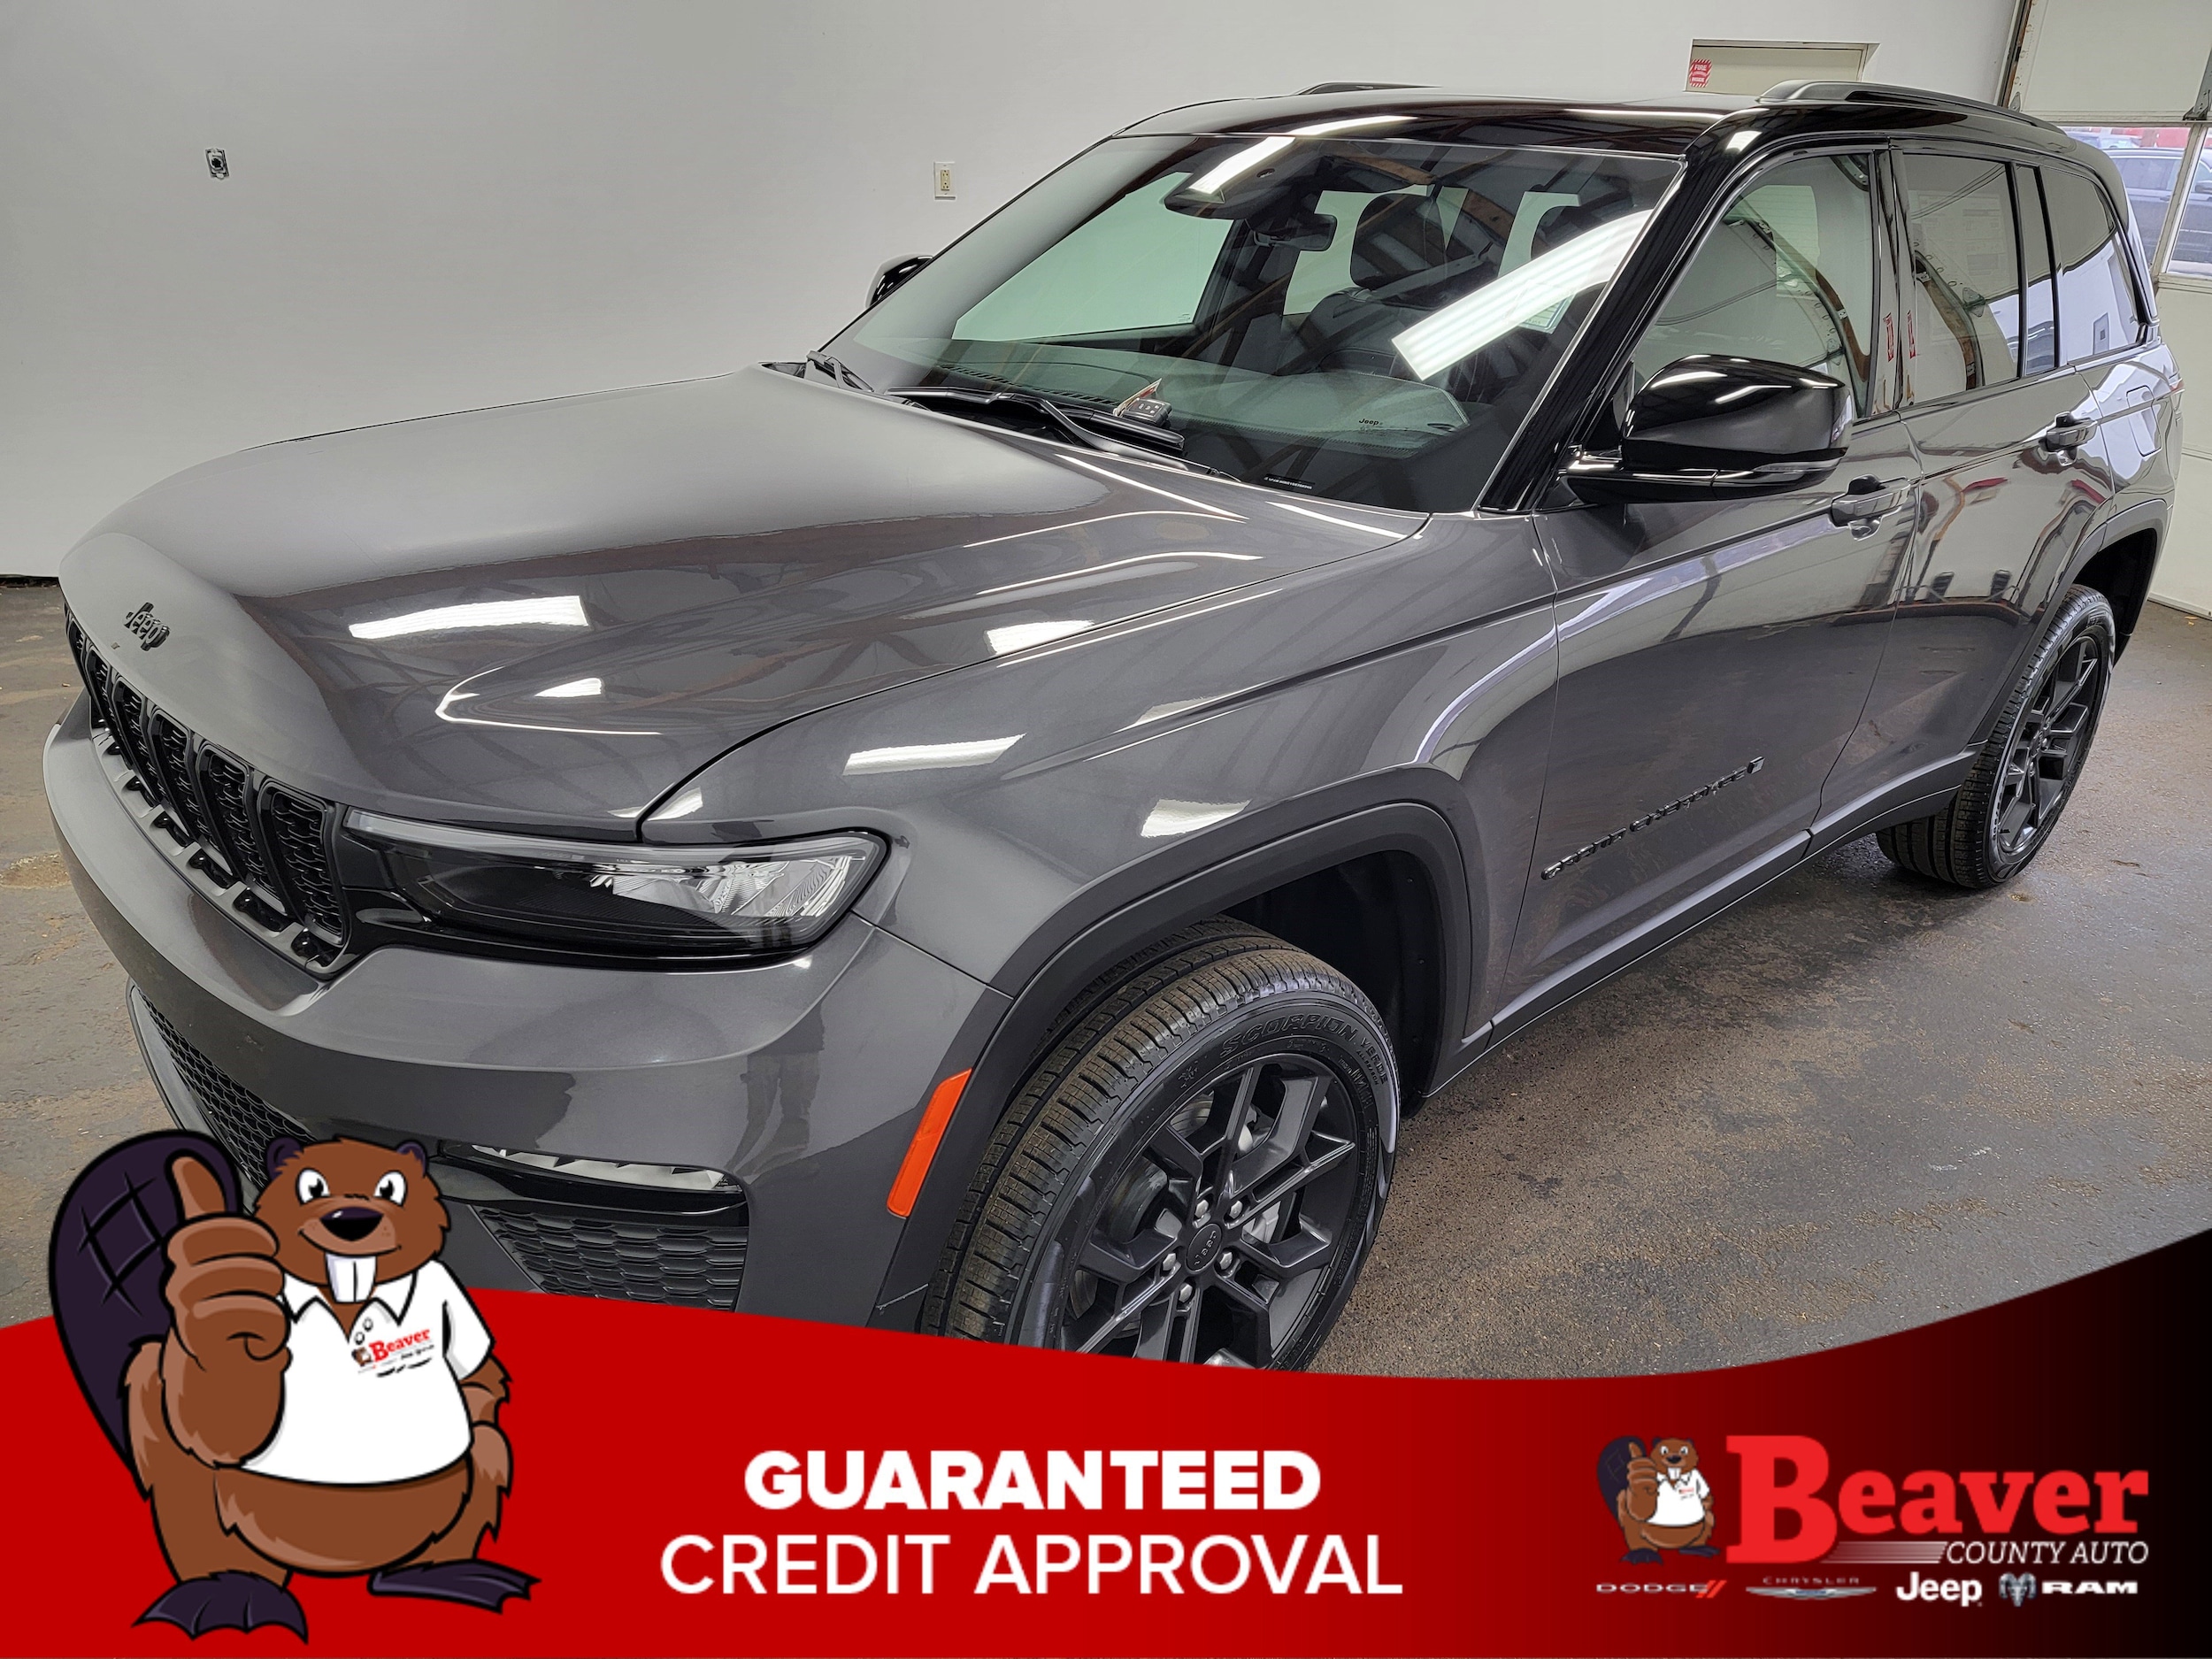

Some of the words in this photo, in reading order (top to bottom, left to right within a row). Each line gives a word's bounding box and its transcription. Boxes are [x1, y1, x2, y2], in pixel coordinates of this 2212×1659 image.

[123, 602, 171, 651] Jeep
[1219, 1013, 1359, 1059] SCORPION
[1194, 1230, 1217, 1266] Jeep
